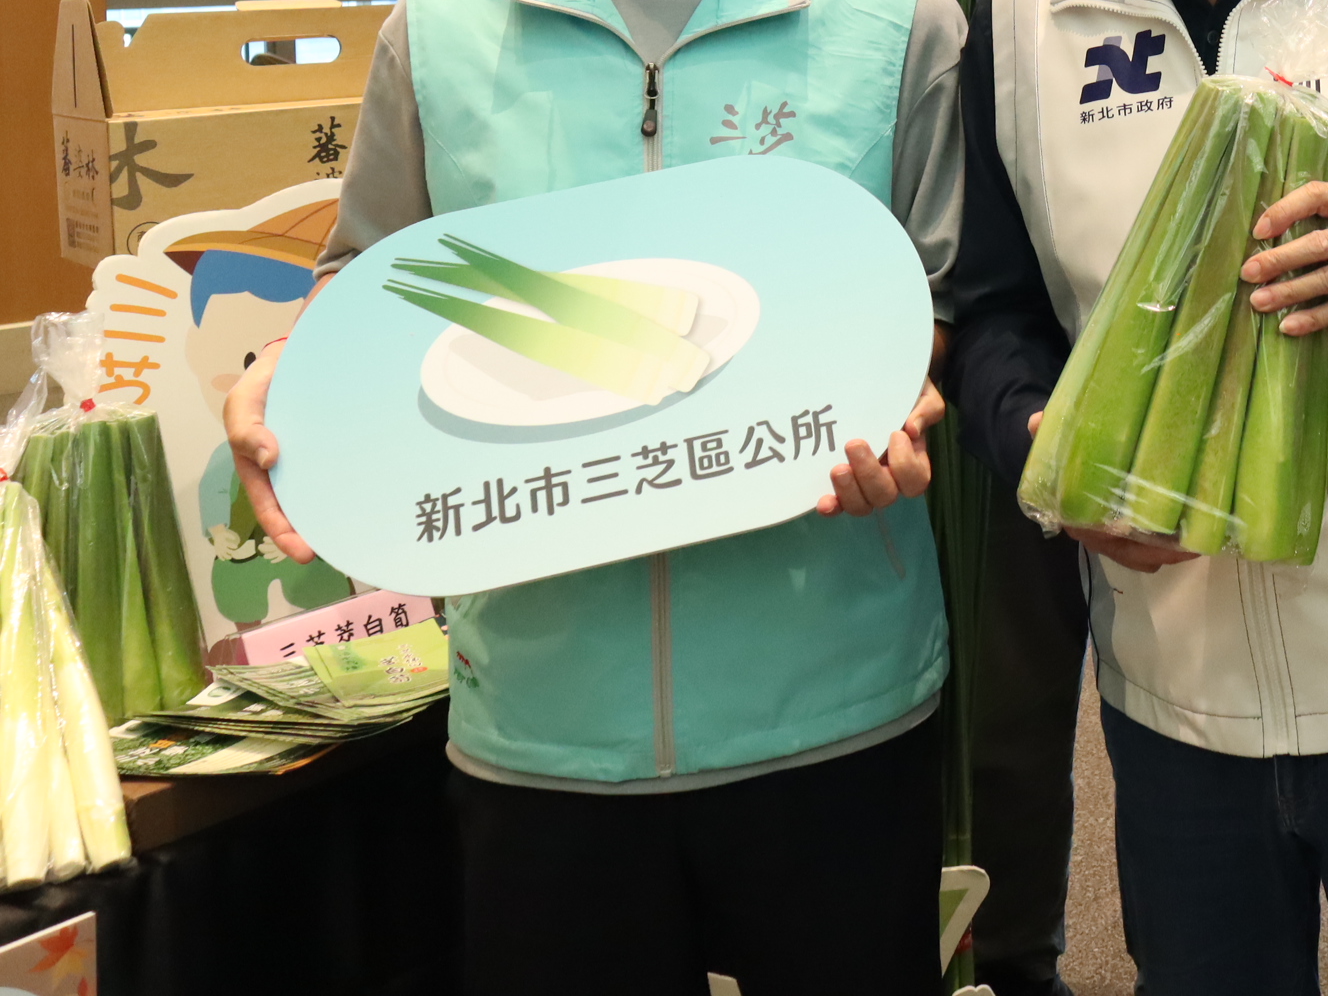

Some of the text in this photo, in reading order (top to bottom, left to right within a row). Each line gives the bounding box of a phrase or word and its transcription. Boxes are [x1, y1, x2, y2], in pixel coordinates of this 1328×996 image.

[1079, 96, 1175, 125] 新北市政府
[414, 404, 838, 544] 新北市三芝區公所
